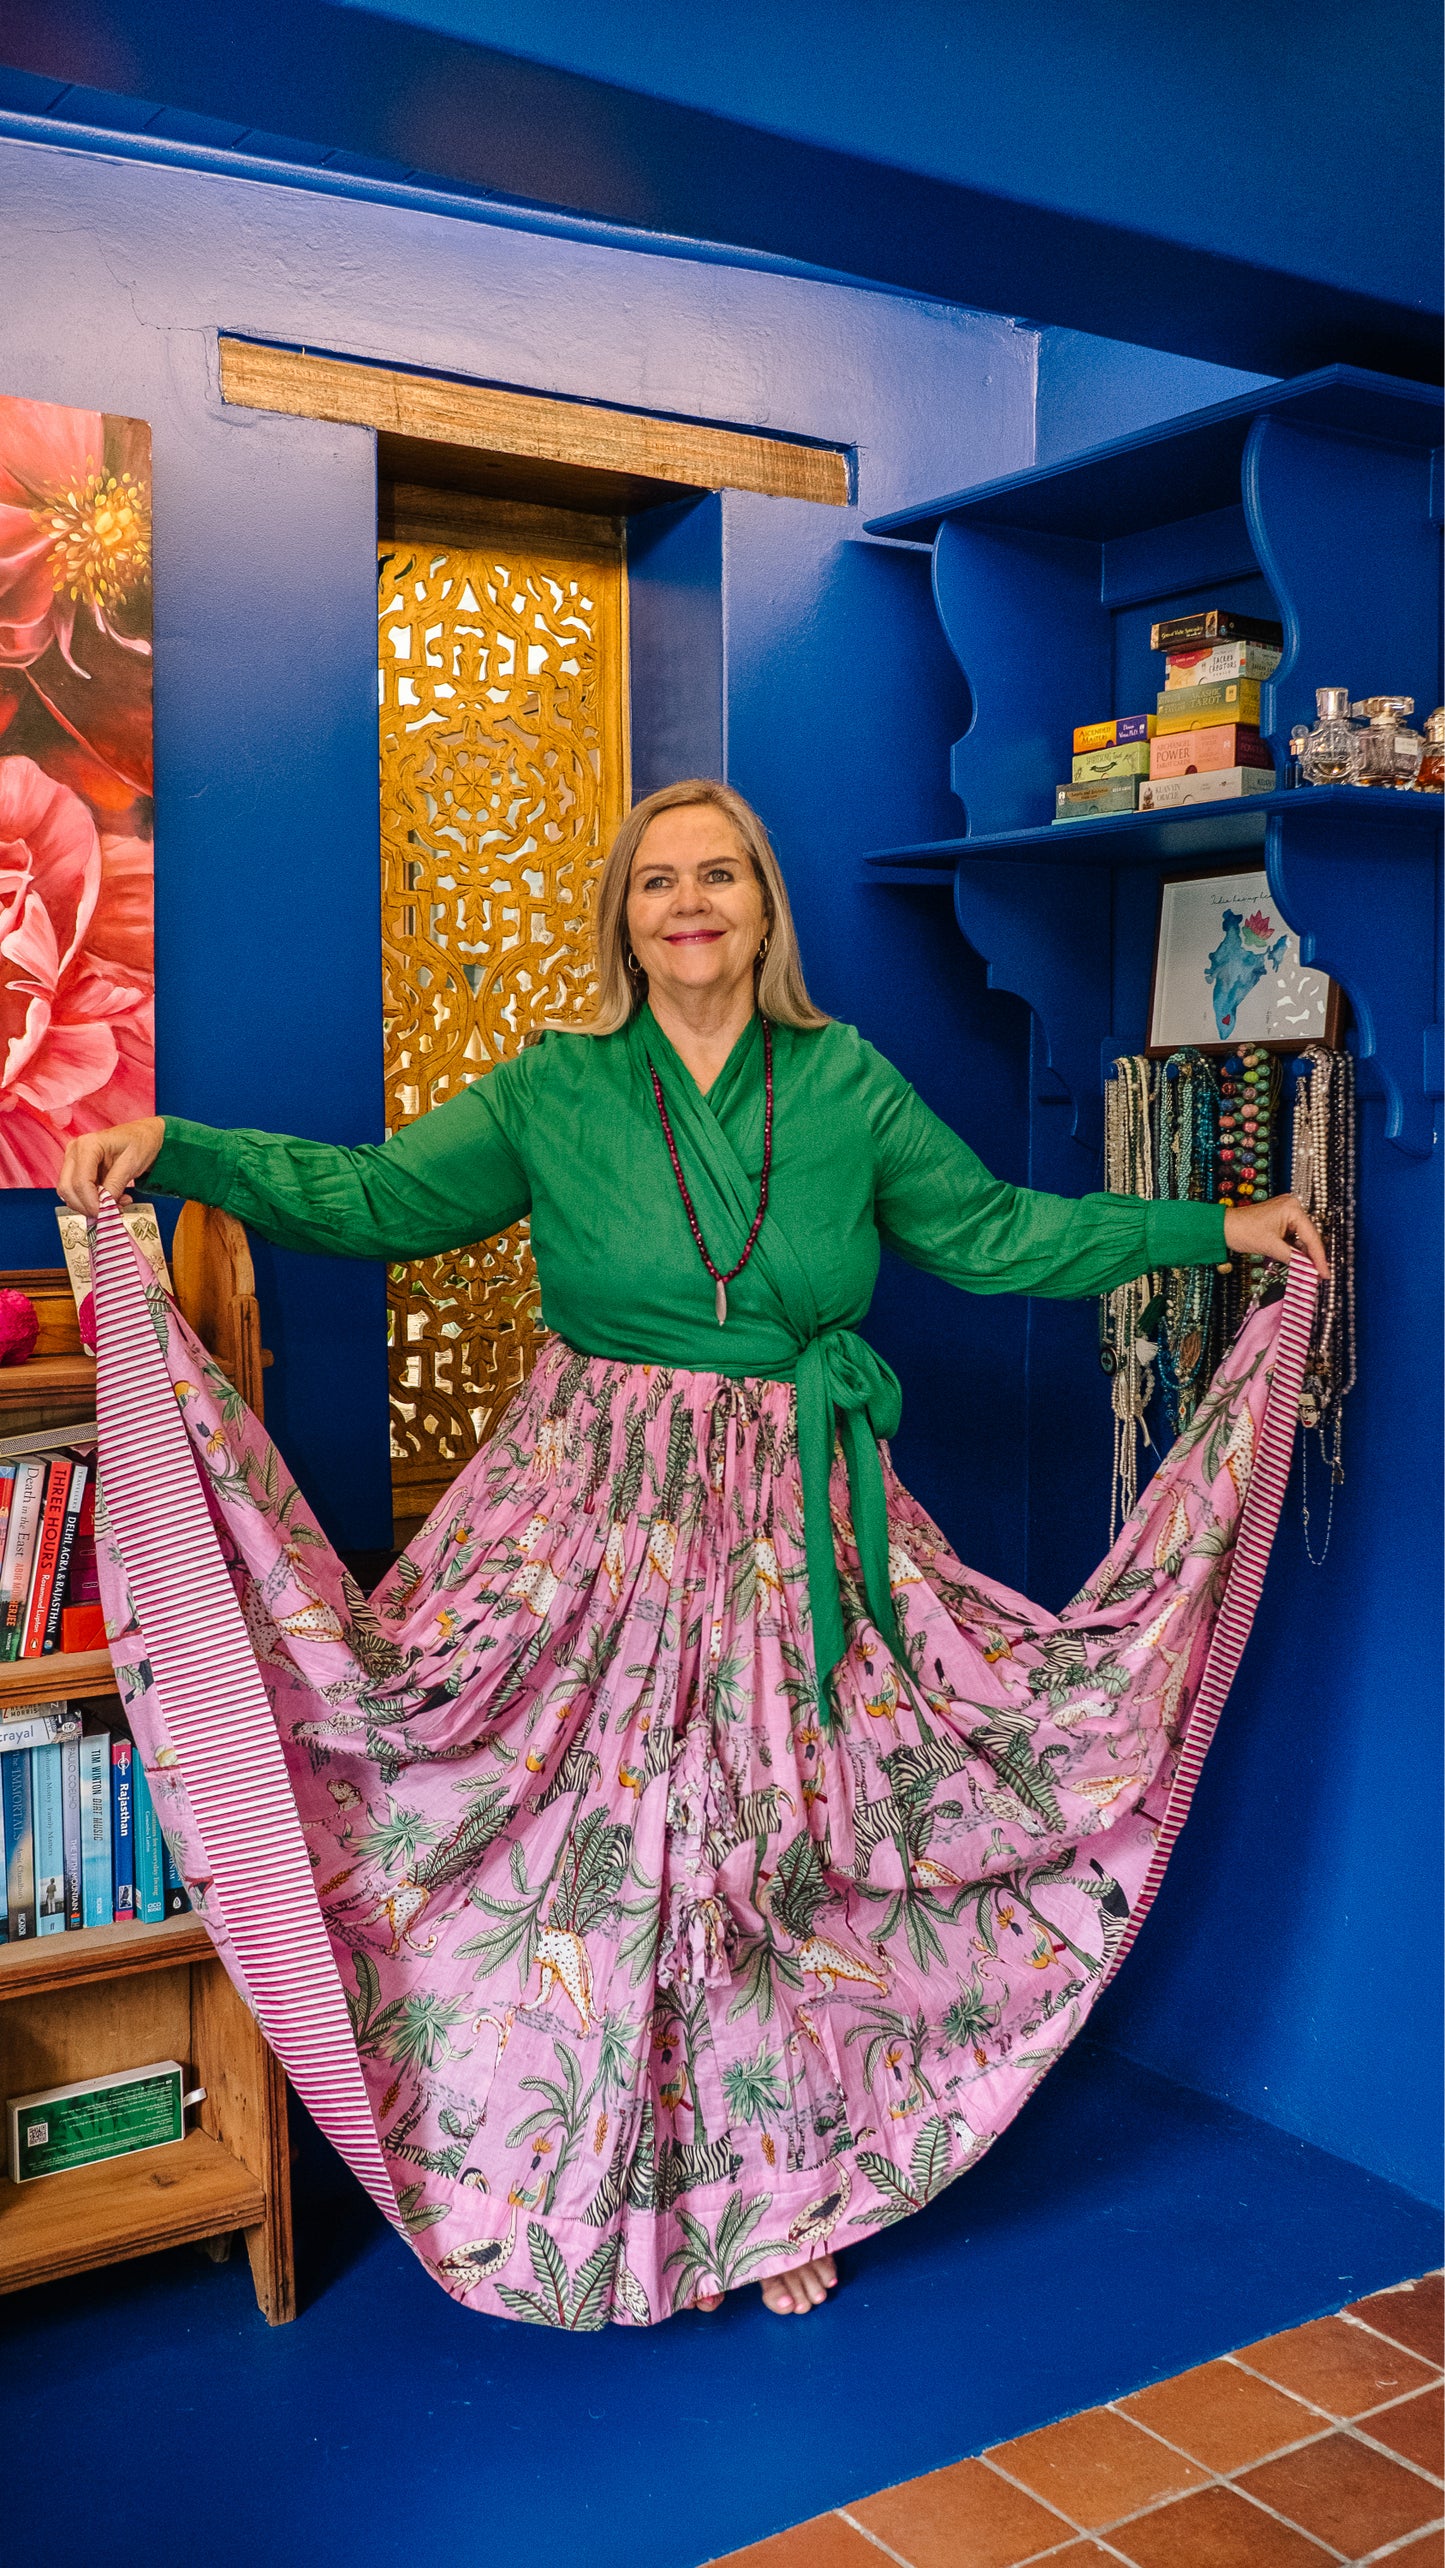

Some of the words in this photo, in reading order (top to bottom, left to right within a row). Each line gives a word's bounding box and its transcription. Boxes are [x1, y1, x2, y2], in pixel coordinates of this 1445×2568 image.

[1191, 696, 1222, 707] TAROT
[1079, 727, 1111, 738] ASCENDED
[1156, 748, 1190, 762] POWER
[23, 1467, 40, 1504] Death
[49, 1470, 67, 1513] THREE
[21, 1506, 28, 1514] in
[20, 1517, 29, 1530] the
[15, 1532, 30, 1557] East
[41, 1517, 60, 1569] HOURS
[13, 1563, 24, 1581] ABIR
[57, 1546, 71, 1574] AGRA
[56, 1573, 66, 1581] &
[6, 1583, 21, 1626] MUHERJEE
[38, 1574, 51, 1609] Rosamund
[46, 1581, 65, 1633] RAJASTHAN
[33, 1608, 45, 1633] Lupton
[10, 1707, 39, 1717] MORRIS
[67, 1746, 77, 1773] PAULO
[91, 1749, 101, 1764] TIM
[68, 1775, 77, 1810] COELHO
[92, 1766, 102, 1795] WINTON
[12, 1769, 24, 1841] IMMORTALS
[92, 1798, 103, 1815] DIRT
[118, 1783, 131, 1837] Rajasthan
[93, 1817, 103, 1841] MUSIC
[71, 1872, 79, 1911] MOUNTAIN
